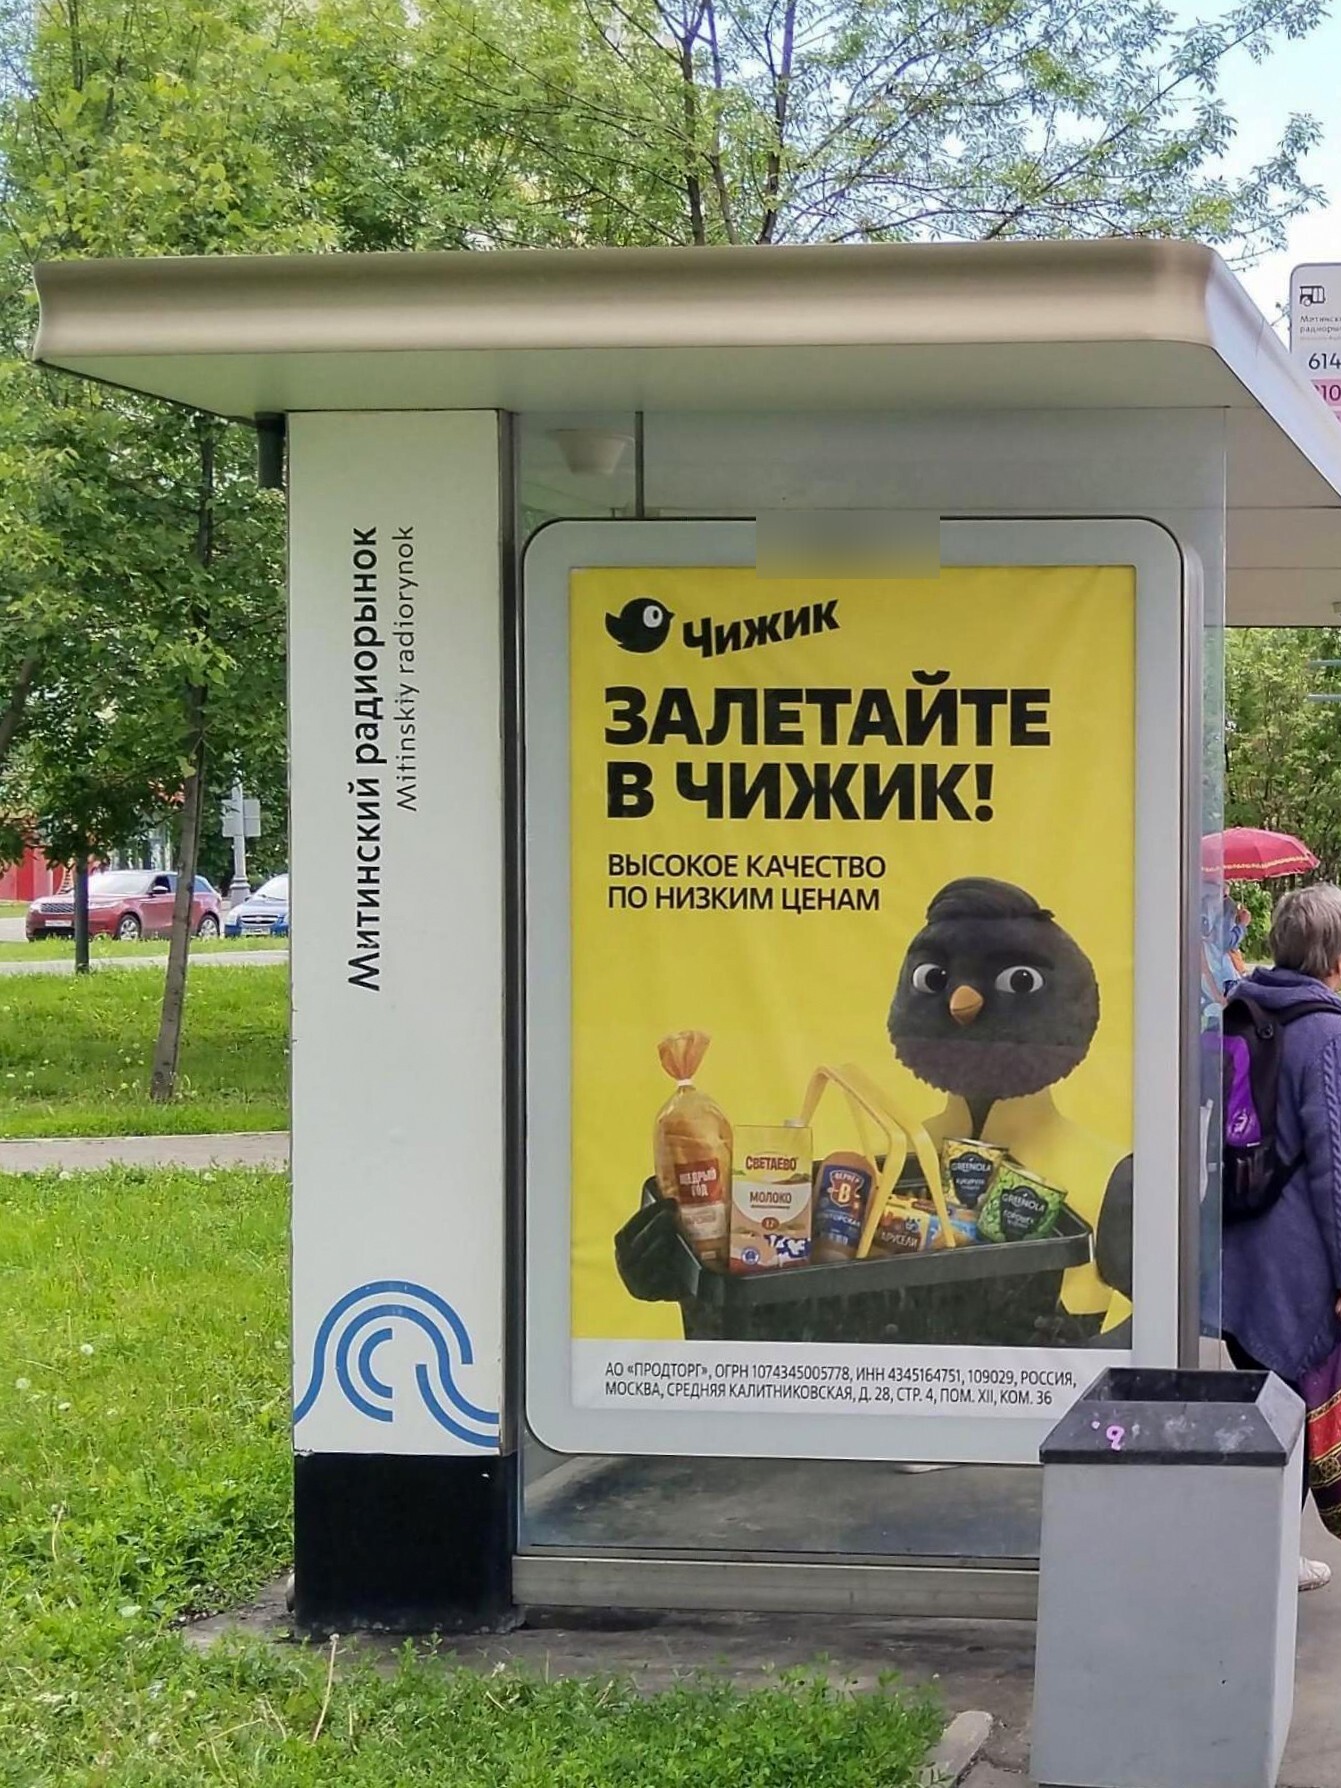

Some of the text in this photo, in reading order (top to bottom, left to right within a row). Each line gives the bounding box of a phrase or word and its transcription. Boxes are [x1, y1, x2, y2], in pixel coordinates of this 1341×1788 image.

[1307, 352, 1341, 370] 614
[1315, 384, 1341, 401] 10
[391, 525, 420, 812] Mitinskiy radiorynok
[604, 669, 1052, 747] ЗАЛЕТАЙТЕ
[347, 526, 387, 992] Митинский радиорынок
[606, 761, 994, 823] В ЧИЖИК!
[607, 853, 887, 879] ВЫСОКОЕ КАЧЕСТВО
[608, 885, 880, 914] ПО НИЗКИМ ЦЕНАМ
[745, 1155, 798, 1172] СВЕТАЕВО
[749, 1191, 792, 1204] МОЛОКО
[605, 1361, 1077, 1388] АО «ПРОДТОРГ», ОГРН 1074345005778, ИНН 4345164751, 109029, РОССИЯ,
[605, 1381, 664, 1399] МОСКВА,
[666, 1382, 726, 1399] СРЕДНЯЯ
[729, 1383, 855, 1401] КАЛИТНИКОВСКАЯ,
[858, 1386, 872, 1403] Д.
[874, 1386, 893, 1403] 28,
[896, 1387, 922, 1402] СТР.
[925, 1388, 937, 1405] 4,
[940, 1388, 975, 1403] ПОМ.
[999, 1390, 1033, 1404] КОМ.
[1036, 1390, 1053, 1405] 36
